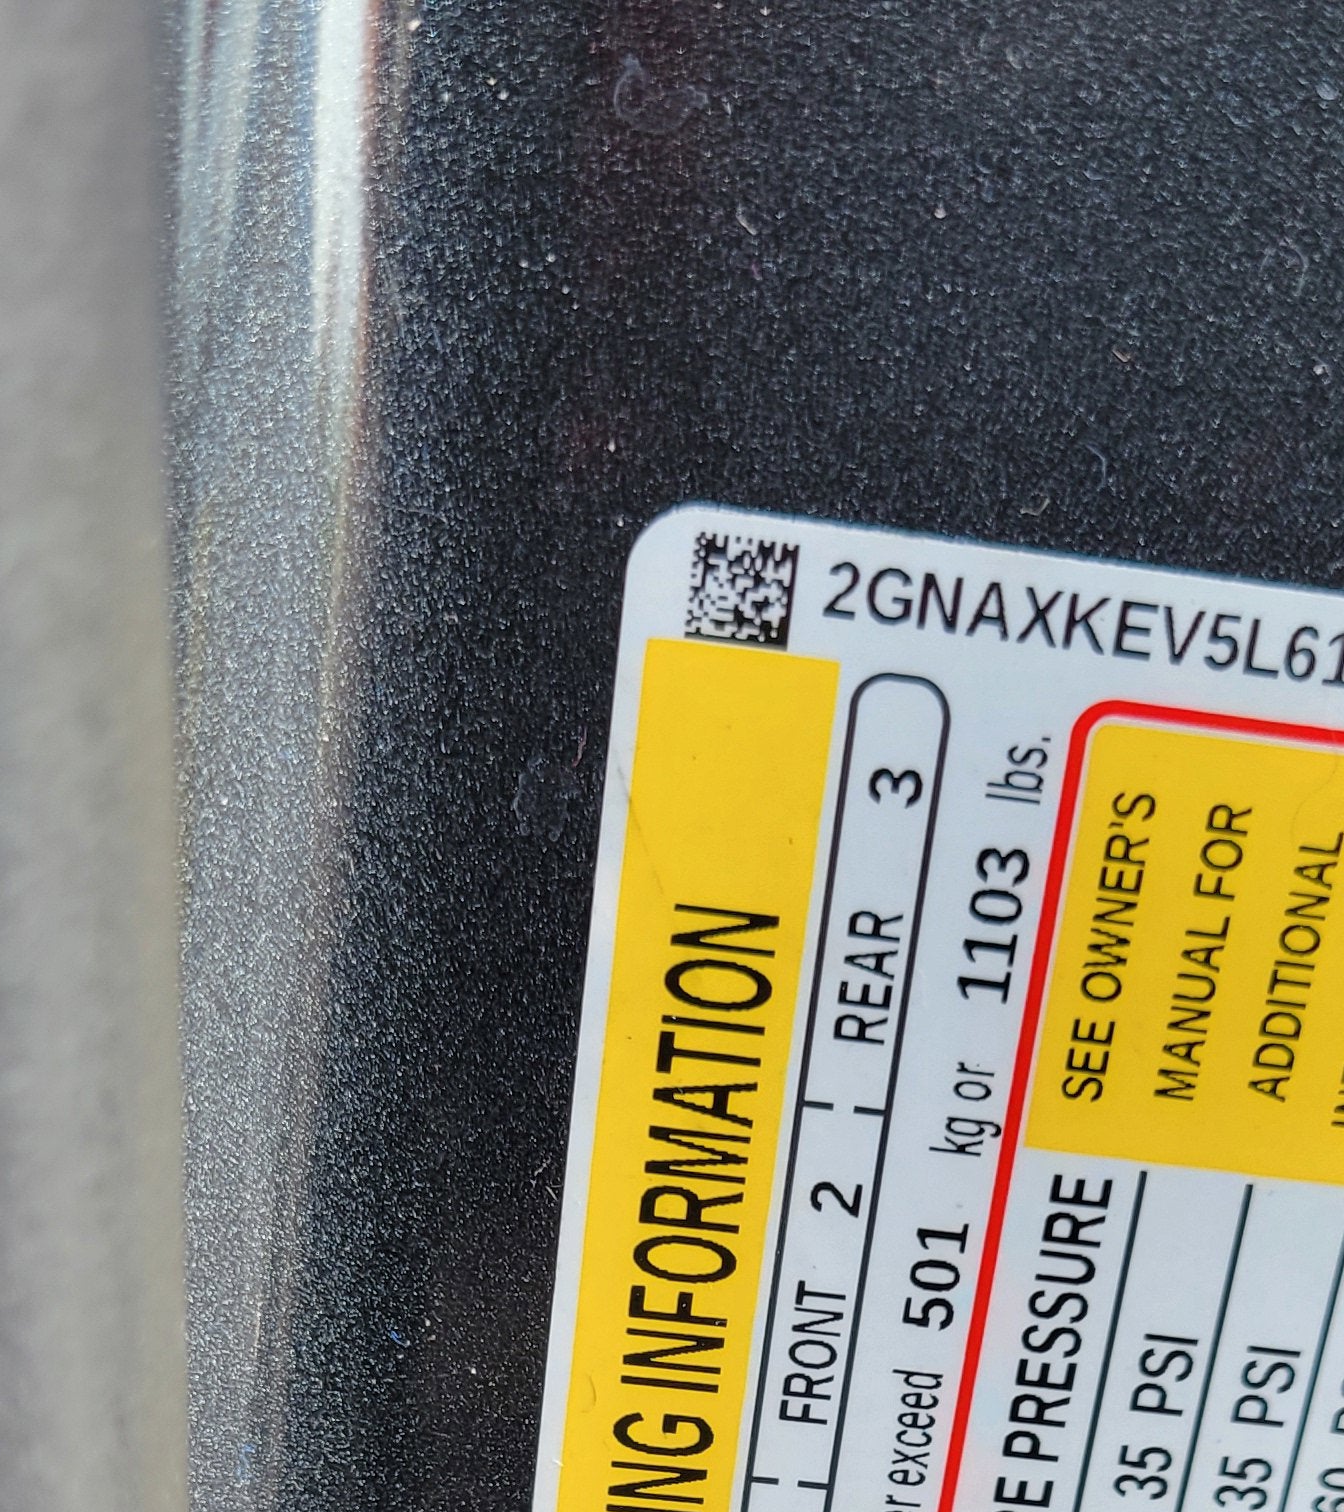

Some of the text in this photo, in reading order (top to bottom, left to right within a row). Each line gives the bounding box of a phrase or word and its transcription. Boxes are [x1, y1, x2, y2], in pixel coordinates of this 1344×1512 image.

[869, 768, 923, 808] 3
[986, 736, 1051, 805] lbs.
[834, 910, 903, 1044] REAR
[957, 848, 1030, 1004] 1103
[1062, 792, 1156, 1102] SEE OWNER'S
[1154, 804, 1252, 1101] MANUAL FOR
[1248, 832, 1344, 1103] ADDITIONAL
[929, 1115, 1002, 1156] kg
[954, 1062, 995, 1102] or
[620, 903, 780, 1394] INFORMATION
[810, 1182, 863, 1218] 2
[903, 1223, 970, 1330] 501
[1003, 1174, 1113, 1462] PRESSURE
[779, 1281, 846, 1425] FRONT
[1130, 1333, 1199, 1416] PSI
[1231, 1345, 1301, 1428] PSI
[888, 1369, 944, 1487] exceed
[1114, 1445, 1173, 1500] 35
[1215, 1456, 1273, 1512] 35
